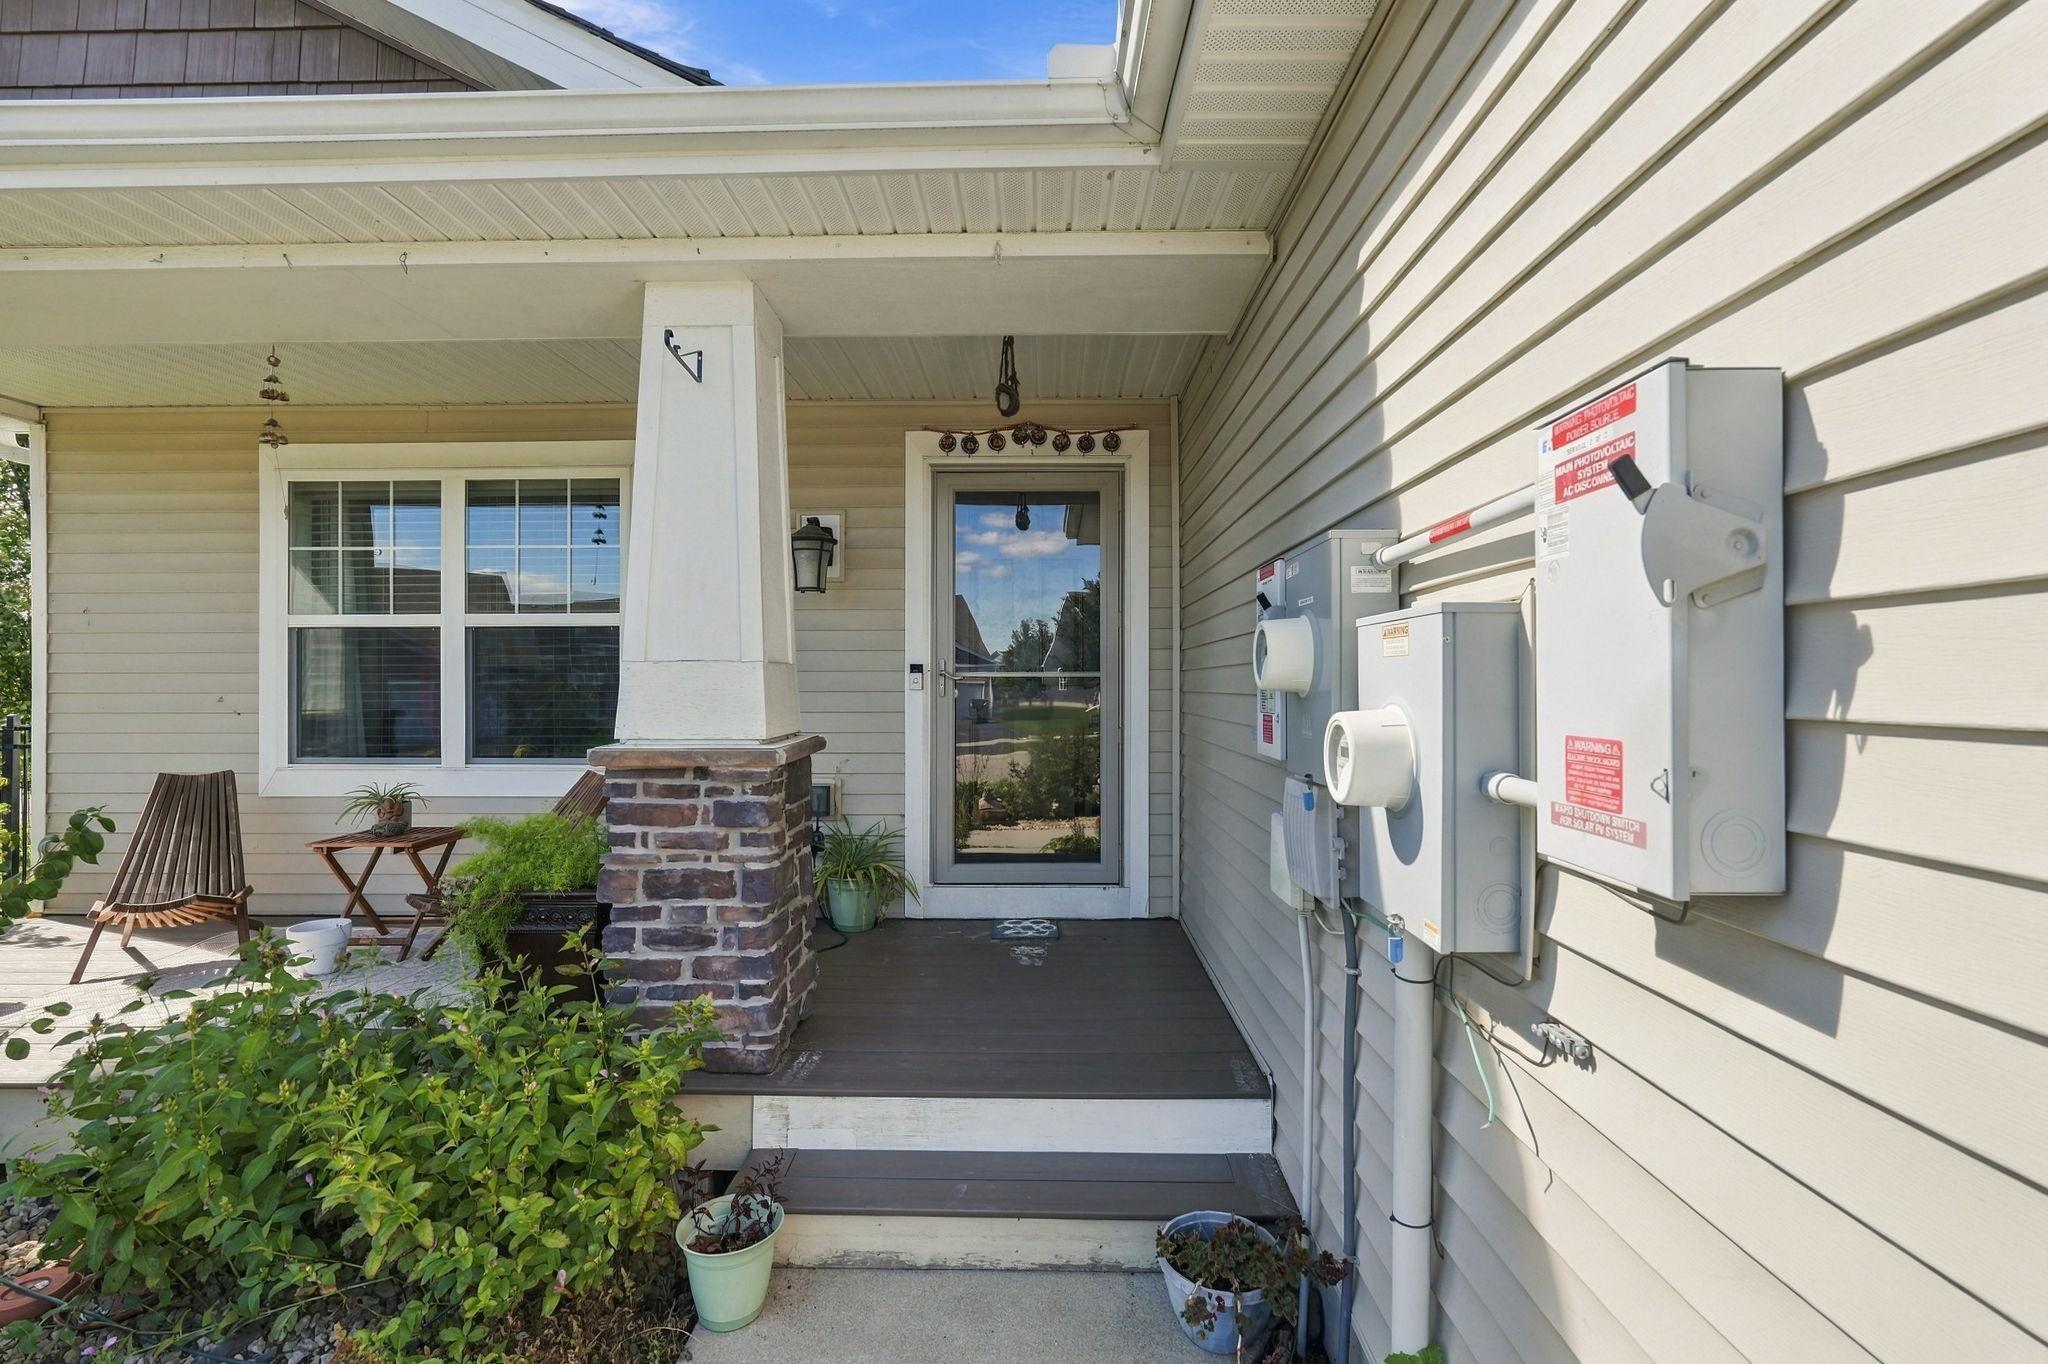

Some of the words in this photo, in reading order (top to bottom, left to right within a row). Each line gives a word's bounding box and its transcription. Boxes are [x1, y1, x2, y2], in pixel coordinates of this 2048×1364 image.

[1584, 387, 1635, 420] PHOTOVOLTAIC
[1566, 424, 1589, 442] POWER
[1590, 409, 1620, 430] SOURCE
[1555, 462, 1574, 476] MAIN
[1574, 436, 1635, 469] PHOTOVOLTAIC
[1577, 460, 1609, 480] SYSTEM
[1563, 484, 1574, 498] AC
[1575, 471, 1616, 493] DISCONNE
[1574, 740, 1612, 755] WARNING
[1555, 804, 1573, 816] RAPID
[1574, 807, 1611, 824] SHUTDOWN
[1612, 817, 1640, 832] SWITCH
[1559, 815, 1573, 828] FOR
[1573, 819, 1594, 832] SOLAR
[1605, 826, 1634, 843] SYSTEM
